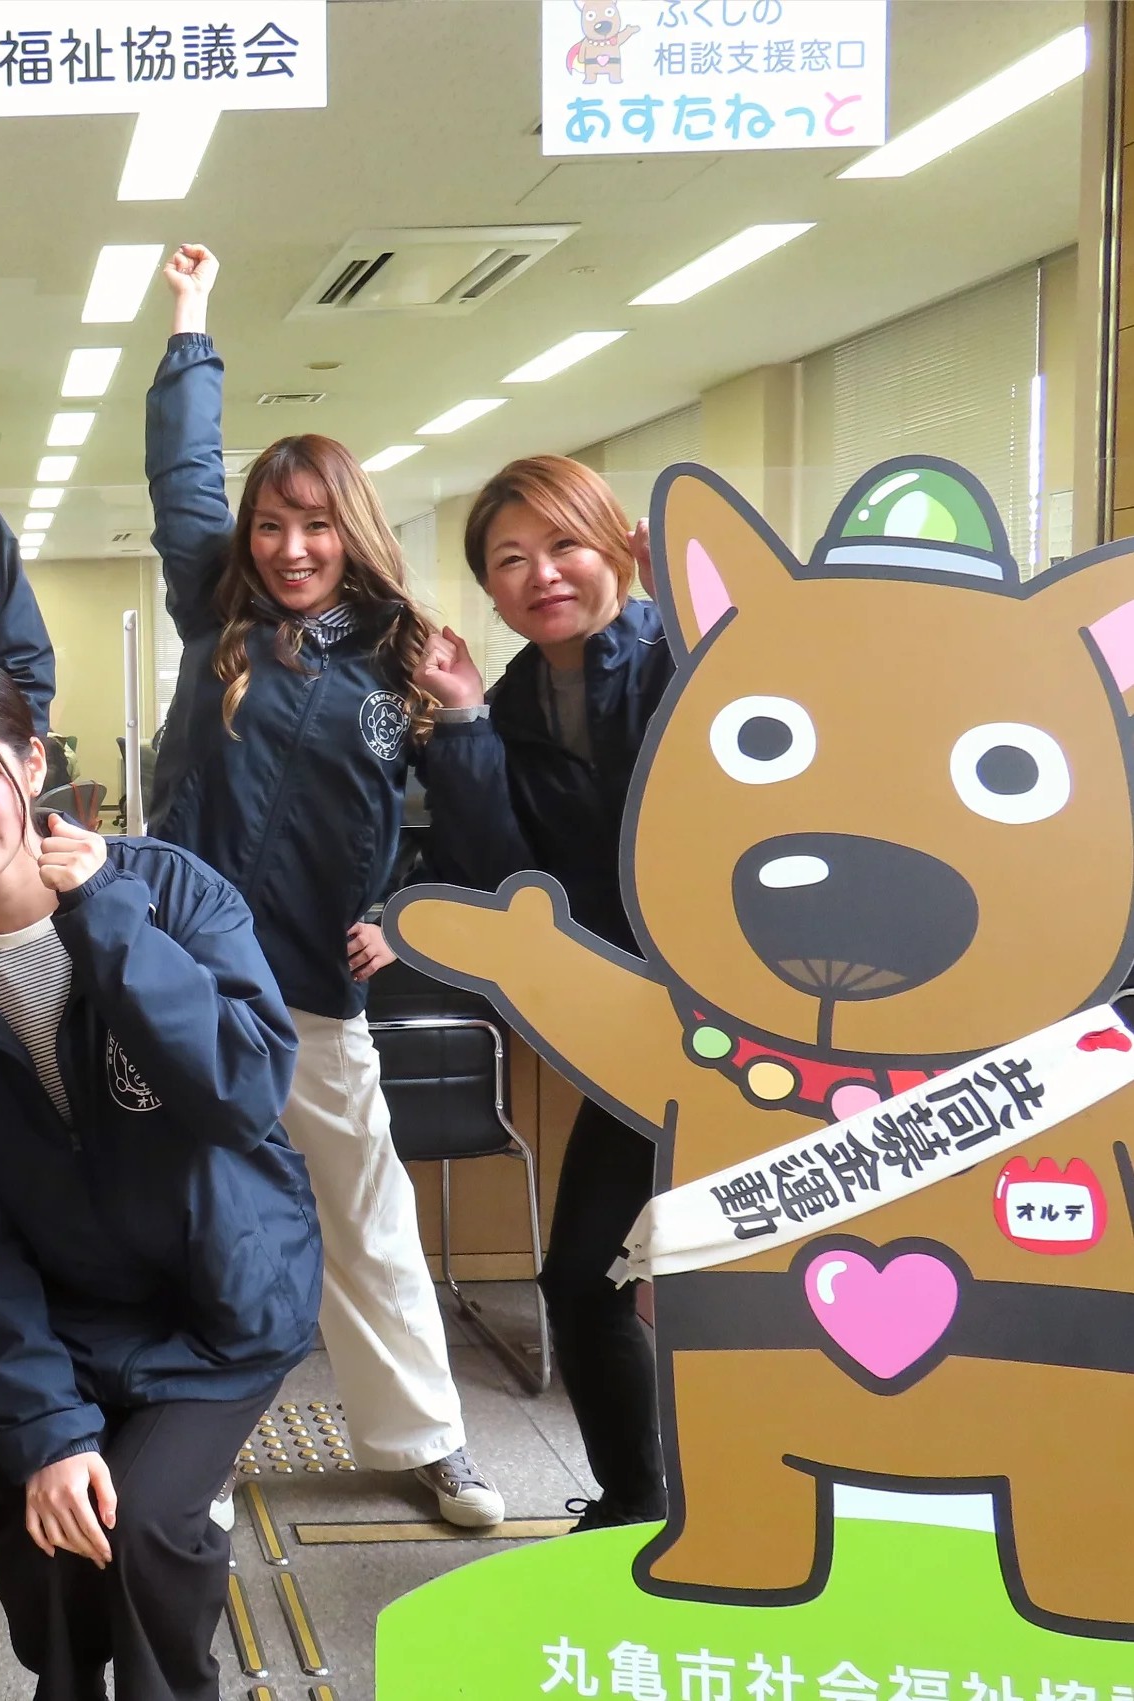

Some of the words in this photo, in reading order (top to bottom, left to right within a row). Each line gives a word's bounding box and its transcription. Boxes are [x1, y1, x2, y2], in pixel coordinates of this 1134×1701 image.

[656, 0, 782, 27] ふくしの
[653, 39, 865, 76] 相談支援窓口
[565, 91, 863, 144] あすたねっと
[709, 1058, 1045, 1241] 共同募金運動
[1015, 1203, 1086, 1223] オルデ
